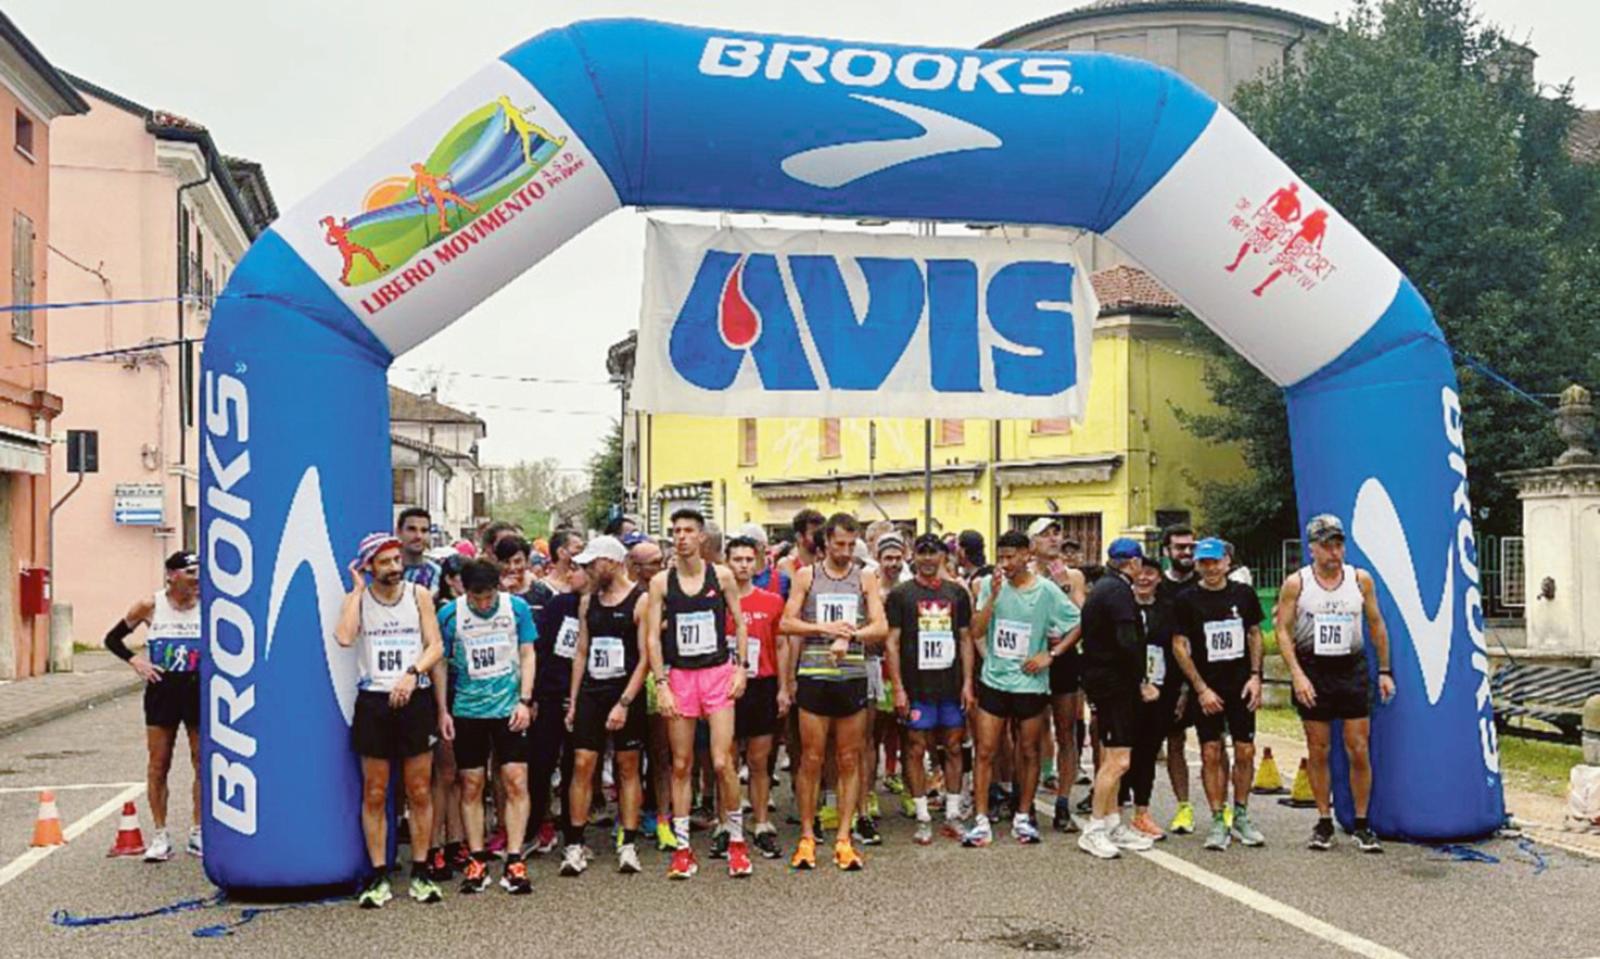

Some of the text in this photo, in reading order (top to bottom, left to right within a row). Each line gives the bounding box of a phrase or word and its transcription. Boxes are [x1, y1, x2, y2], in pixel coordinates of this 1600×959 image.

[699, 36, 1074, 96] BROOKS
[361, 180, 545, 315] LIBERO MOVIMENTO
[668, 248, 1078, 396] AVIS
[204, 369, 257, 836] BROOKS
[1319, 624, 1342, 645] 676
[378, 649, 402, 671] 664
